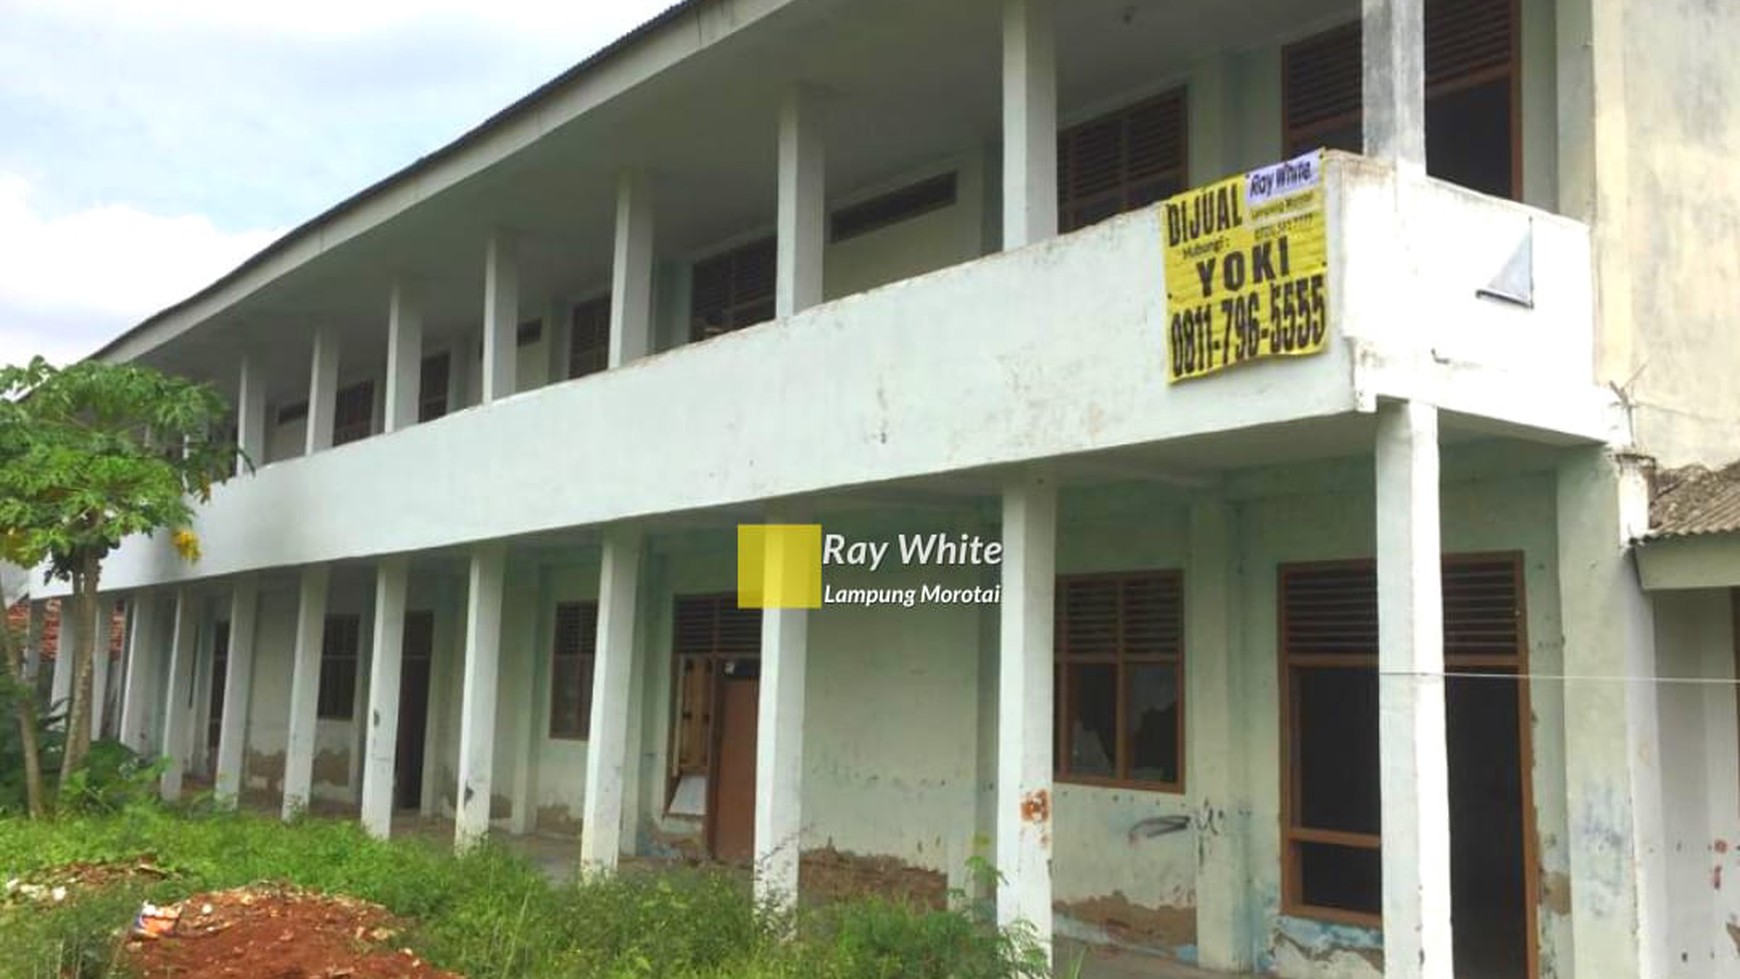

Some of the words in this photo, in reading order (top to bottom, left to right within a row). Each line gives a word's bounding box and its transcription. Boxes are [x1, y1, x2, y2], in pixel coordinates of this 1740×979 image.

[1166, 183, 1243, 248] DIJUAL
[1249, 173, 1274, 198] Ray
[1196, 236, 1290, 298] YOKI
[1170, 273, 1327, 378] 0811-796-5555
